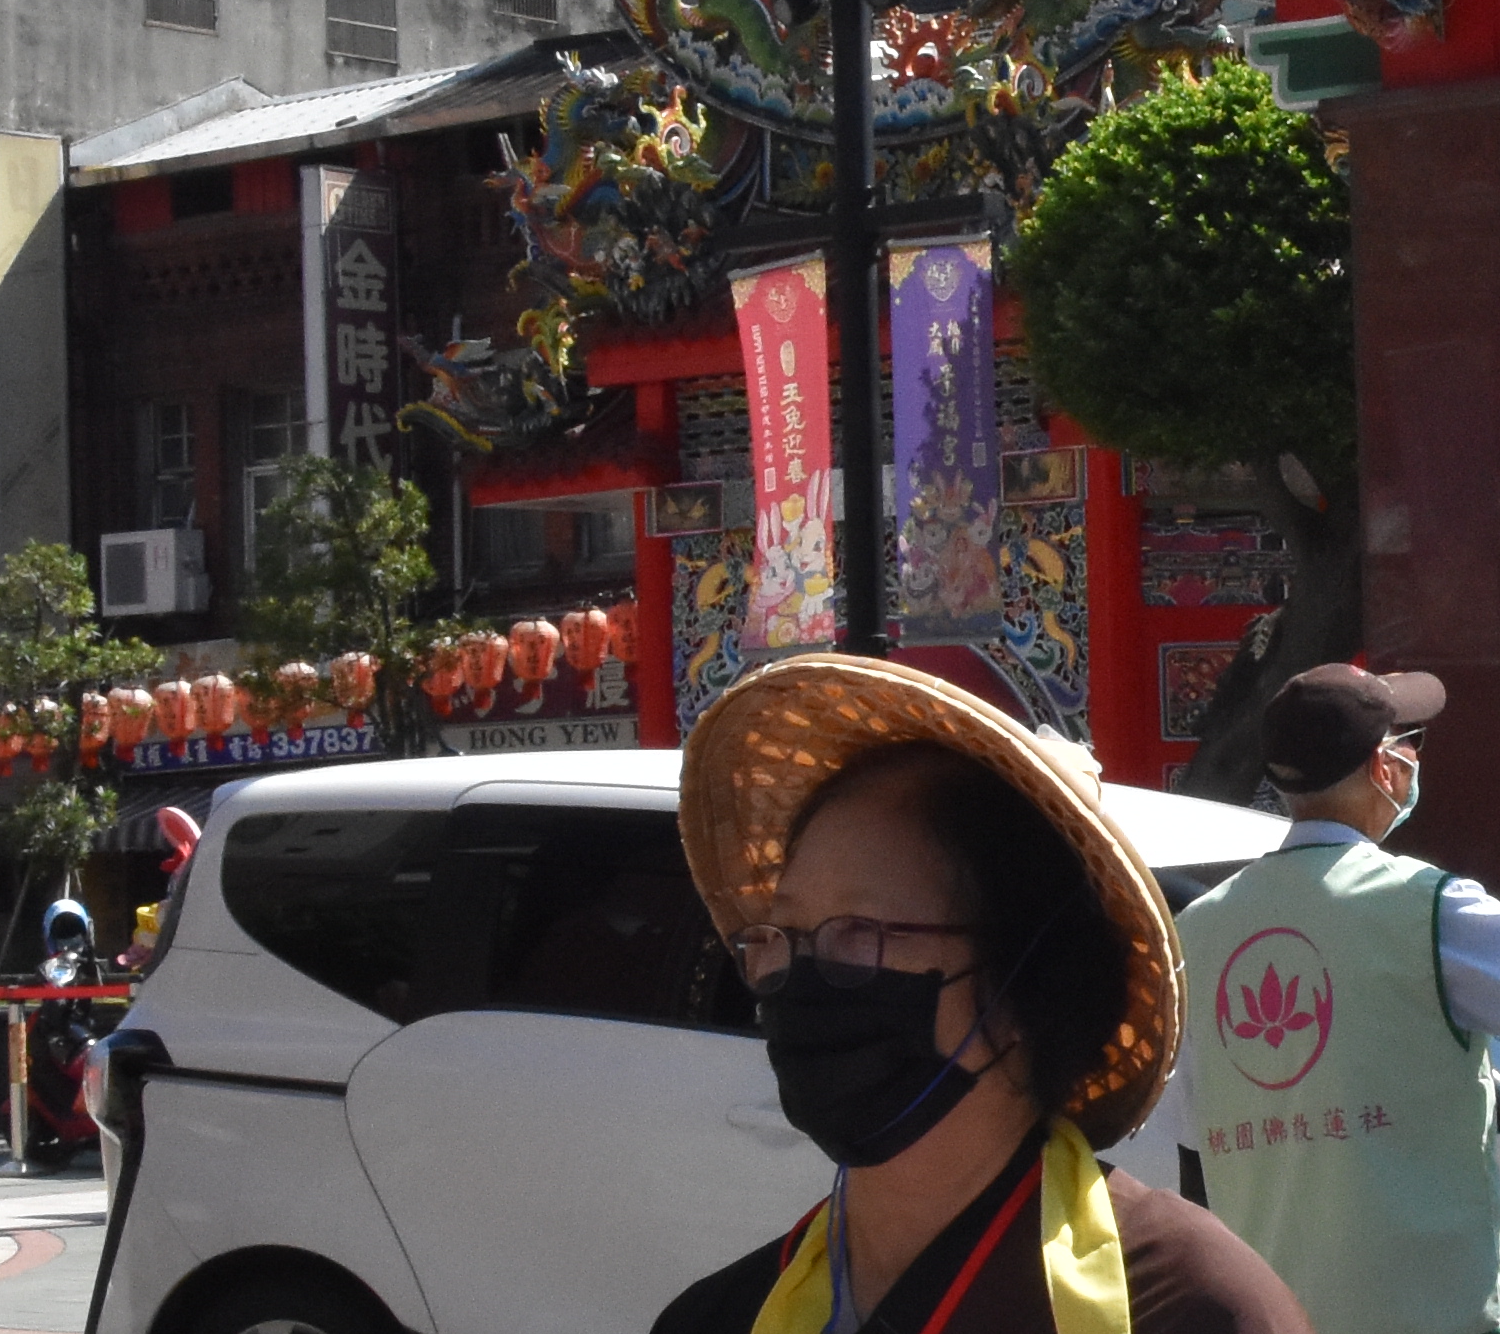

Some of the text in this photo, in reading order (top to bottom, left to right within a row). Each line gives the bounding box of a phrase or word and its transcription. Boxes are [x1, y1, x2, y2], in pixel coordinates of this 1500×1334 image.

[334, 236, 393, 474] 金時代
[780, 382, 808, 485] 玉兔迎春
[469, 721, 620, 750] HONG YEW
